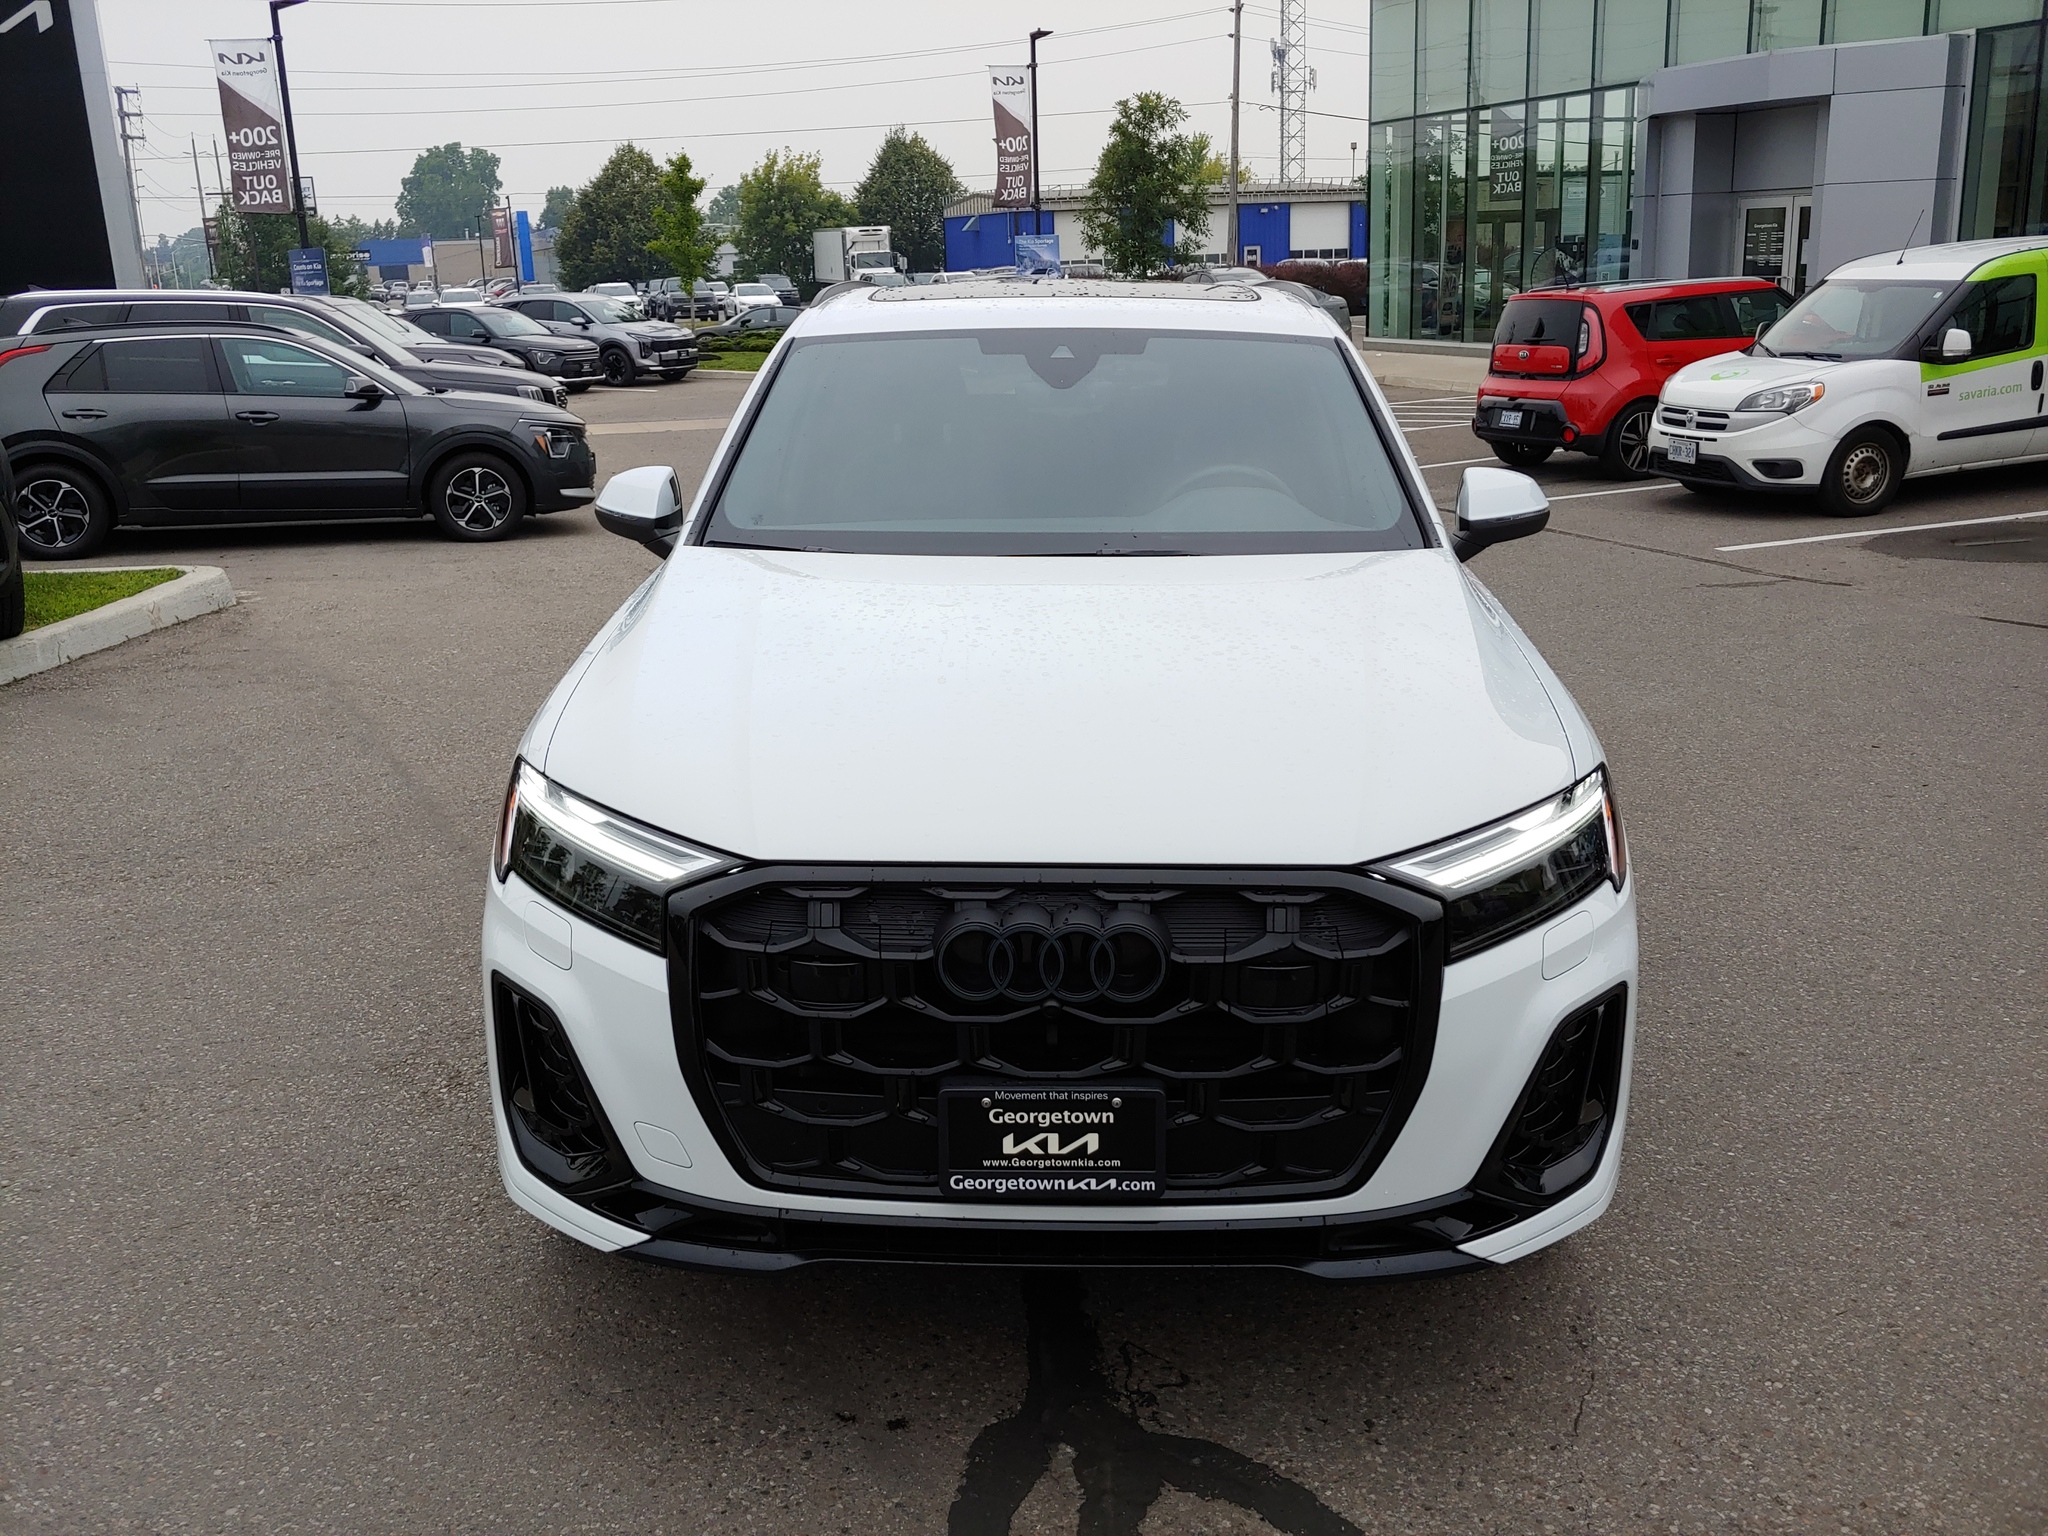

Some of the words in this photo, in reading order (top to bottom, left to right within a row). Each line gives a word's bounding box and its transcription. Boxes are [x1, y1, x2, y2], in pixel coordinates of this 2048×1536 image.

[1959, 383, 2023, 402] savaria.com
[994, 1090, 1048, 1101] Movement
[1049, 1091, 1068, 1101] that
[1071, 1090, 1108, 1102] inspires
[988, 1108, 1114, 1127] Georgetown
[1002, 1132, 1099, 1155] KIA
[983, 1157, 1121, 1168] www.Georgetownkia.com
